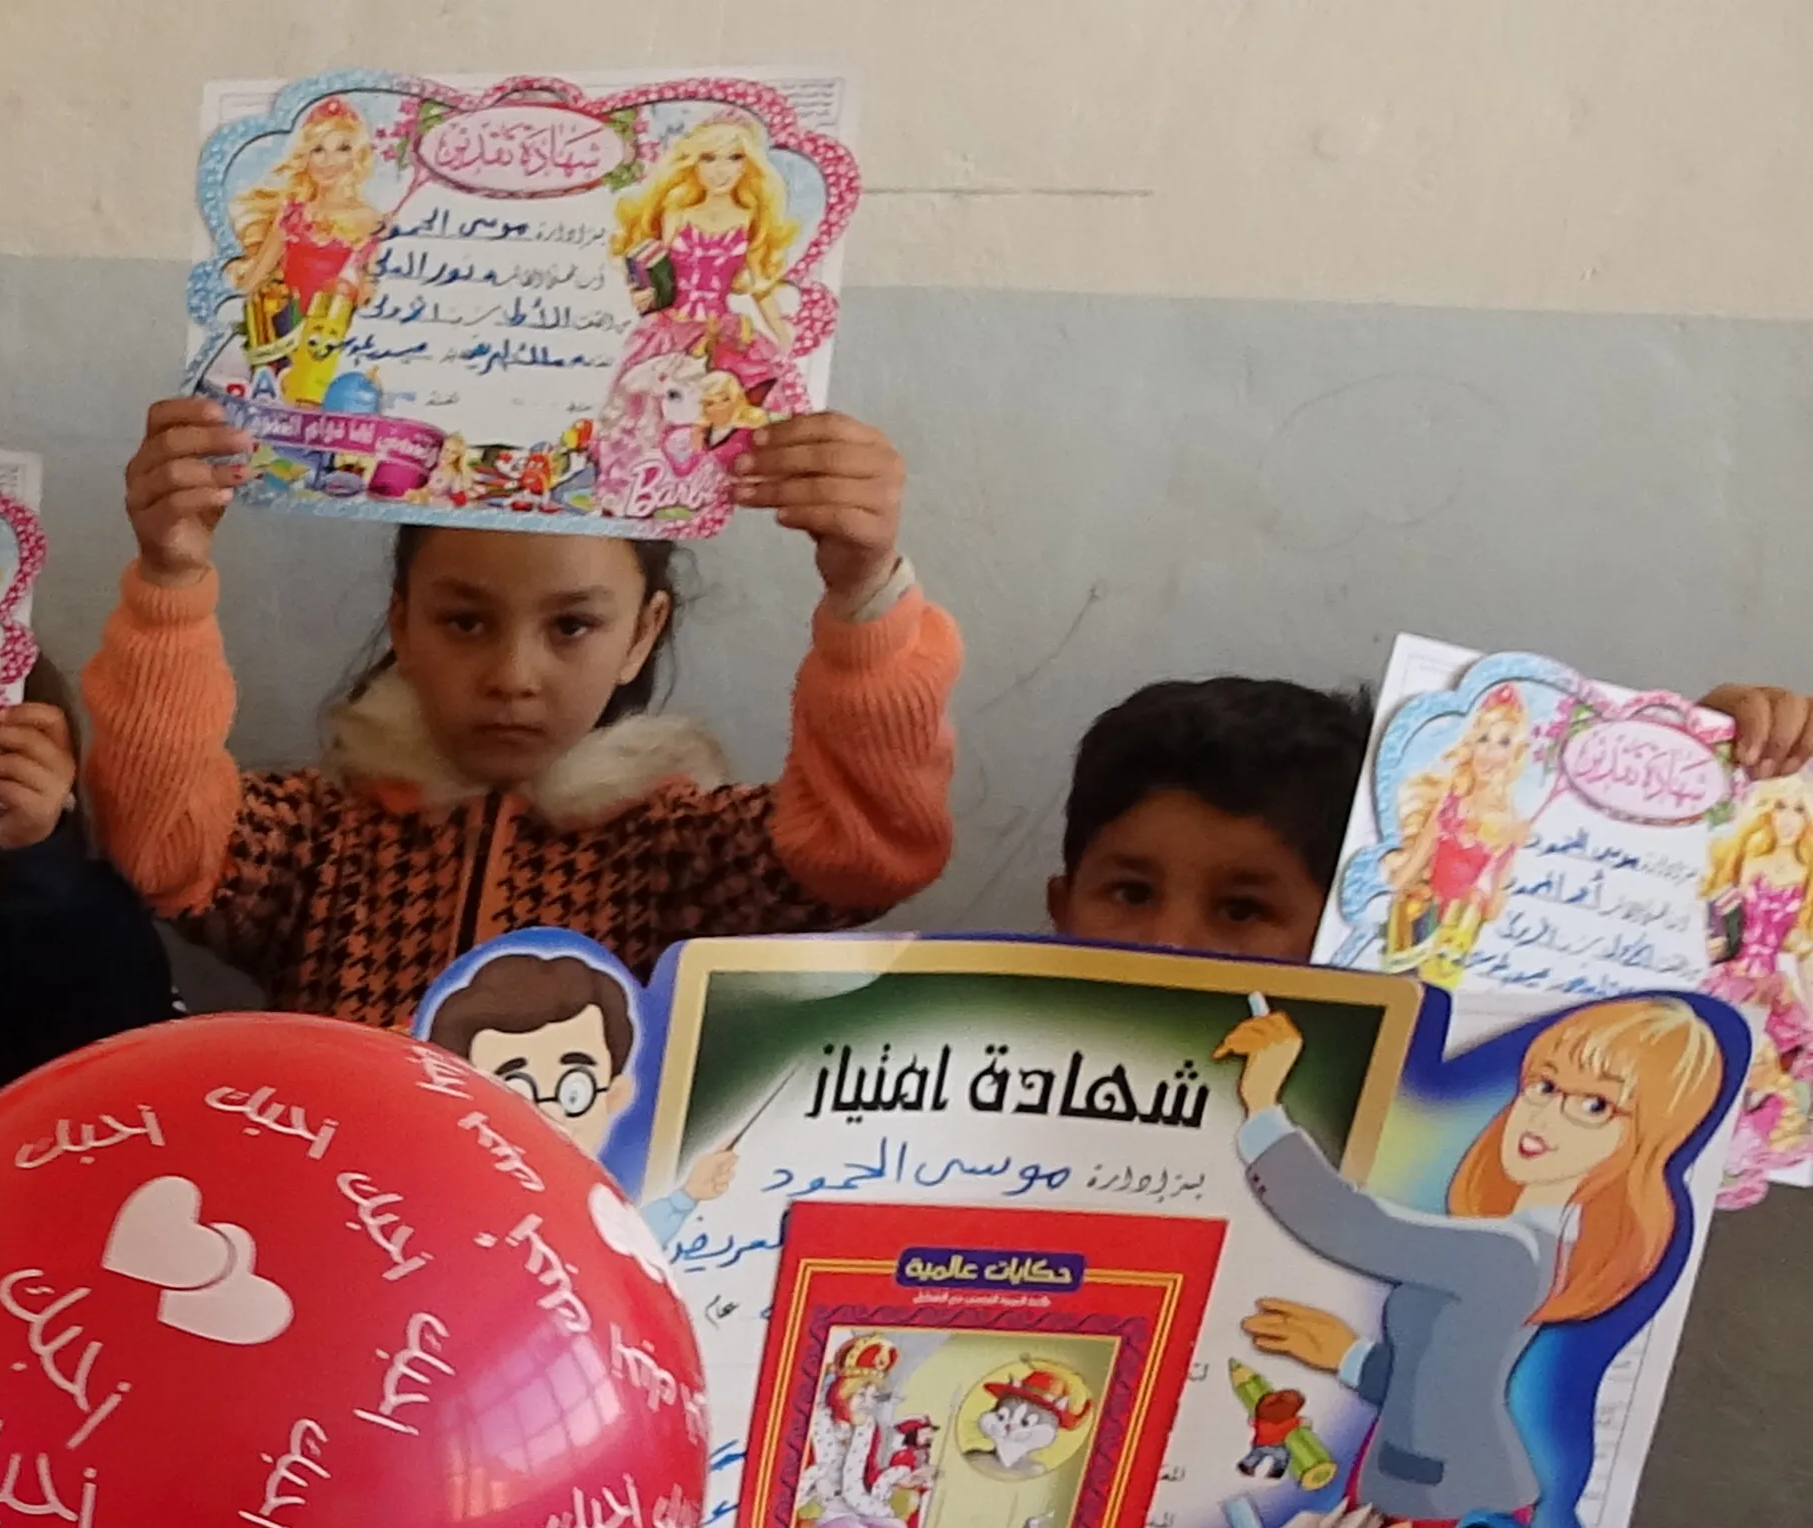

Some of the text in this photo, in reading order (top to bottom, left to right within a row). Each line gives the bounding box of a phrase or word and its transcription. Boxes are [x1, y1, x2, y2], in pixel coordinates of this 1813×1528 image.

[805, 1042, 1211, 1129] شهادة امتياز
[904, 1254, 1074, 1285] حكايات عالمية
